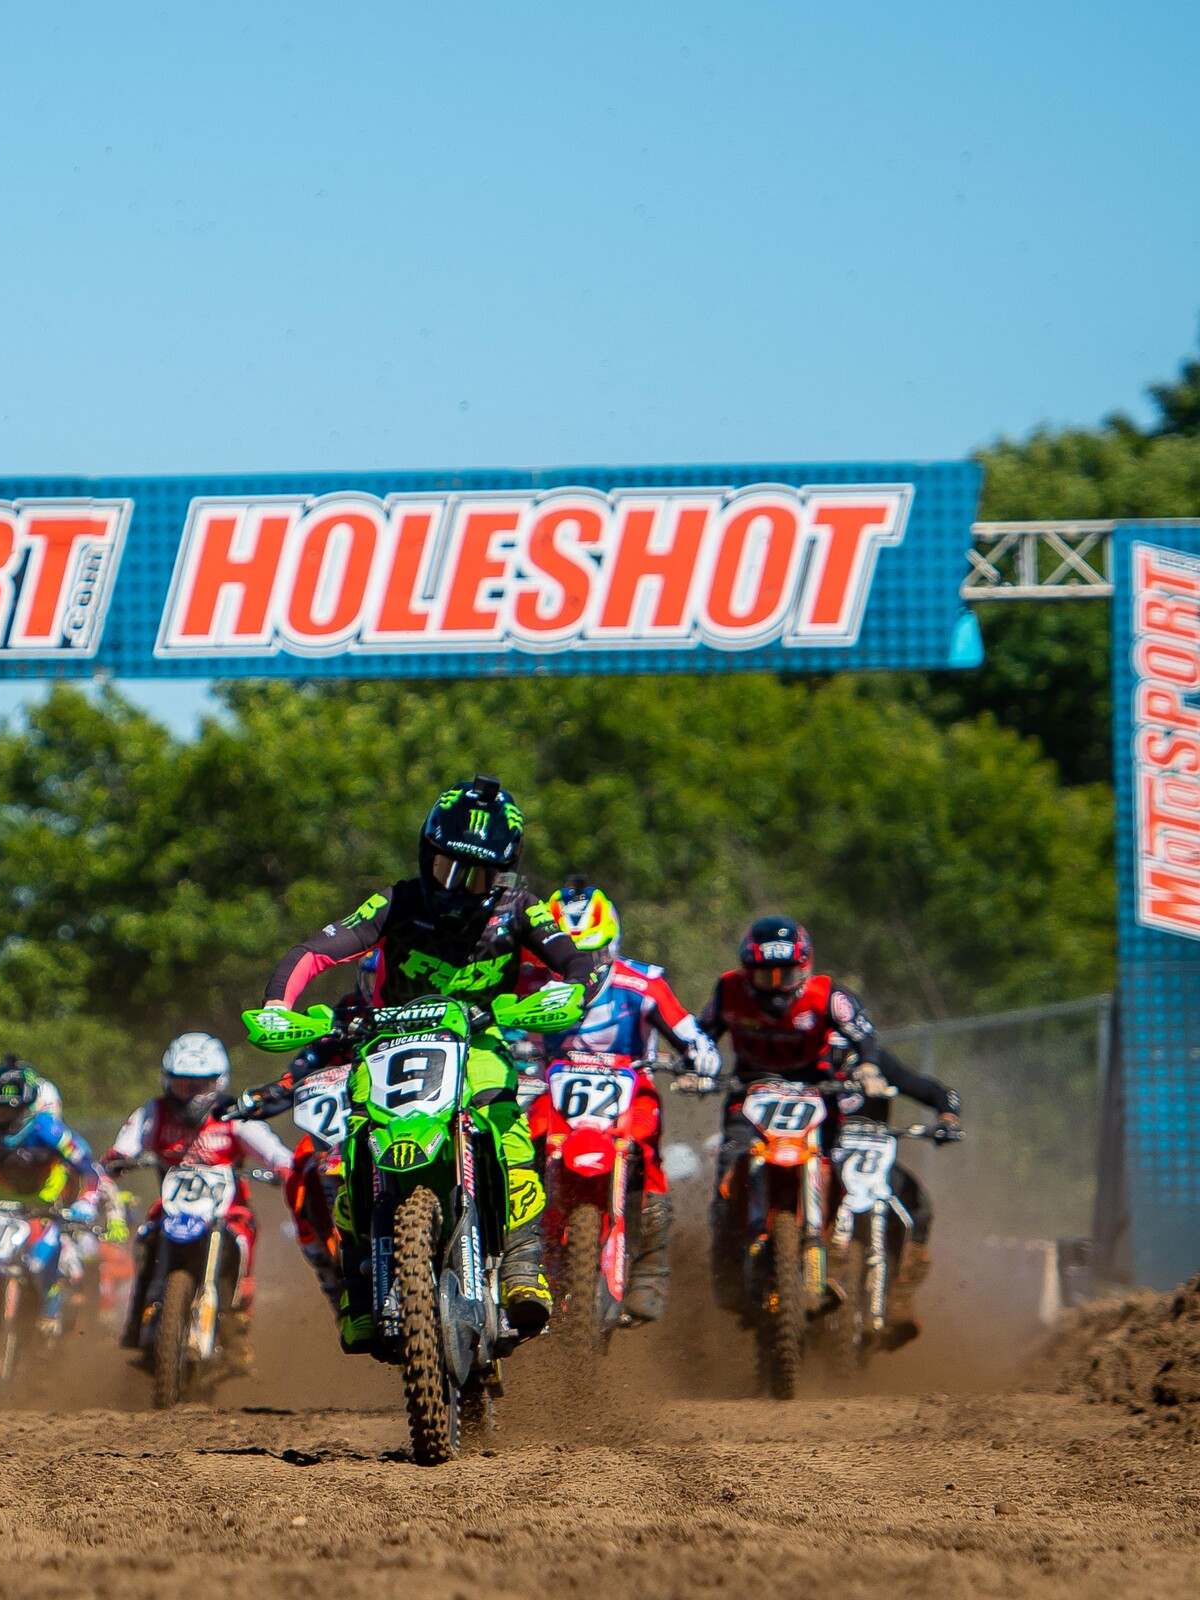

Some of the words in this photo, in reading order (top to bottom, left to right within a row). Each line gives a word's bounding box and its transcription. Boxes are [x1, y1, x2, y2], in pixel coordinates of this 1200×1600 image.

[175, 500, 894, 644] HOLESHOT
[259, 1028, 316, 1042] ACERBIS
[511, 1010, 569, 1026] ACERBIS
[389, 1034, 419, 1048] LUCAS
[420, 1033, 438, 1042] OIL
[385, 1048, 448, 1110] 9
[560, 1078, 622, 1119] 62
[460, 1235, 472, 1282] CARRILLO
